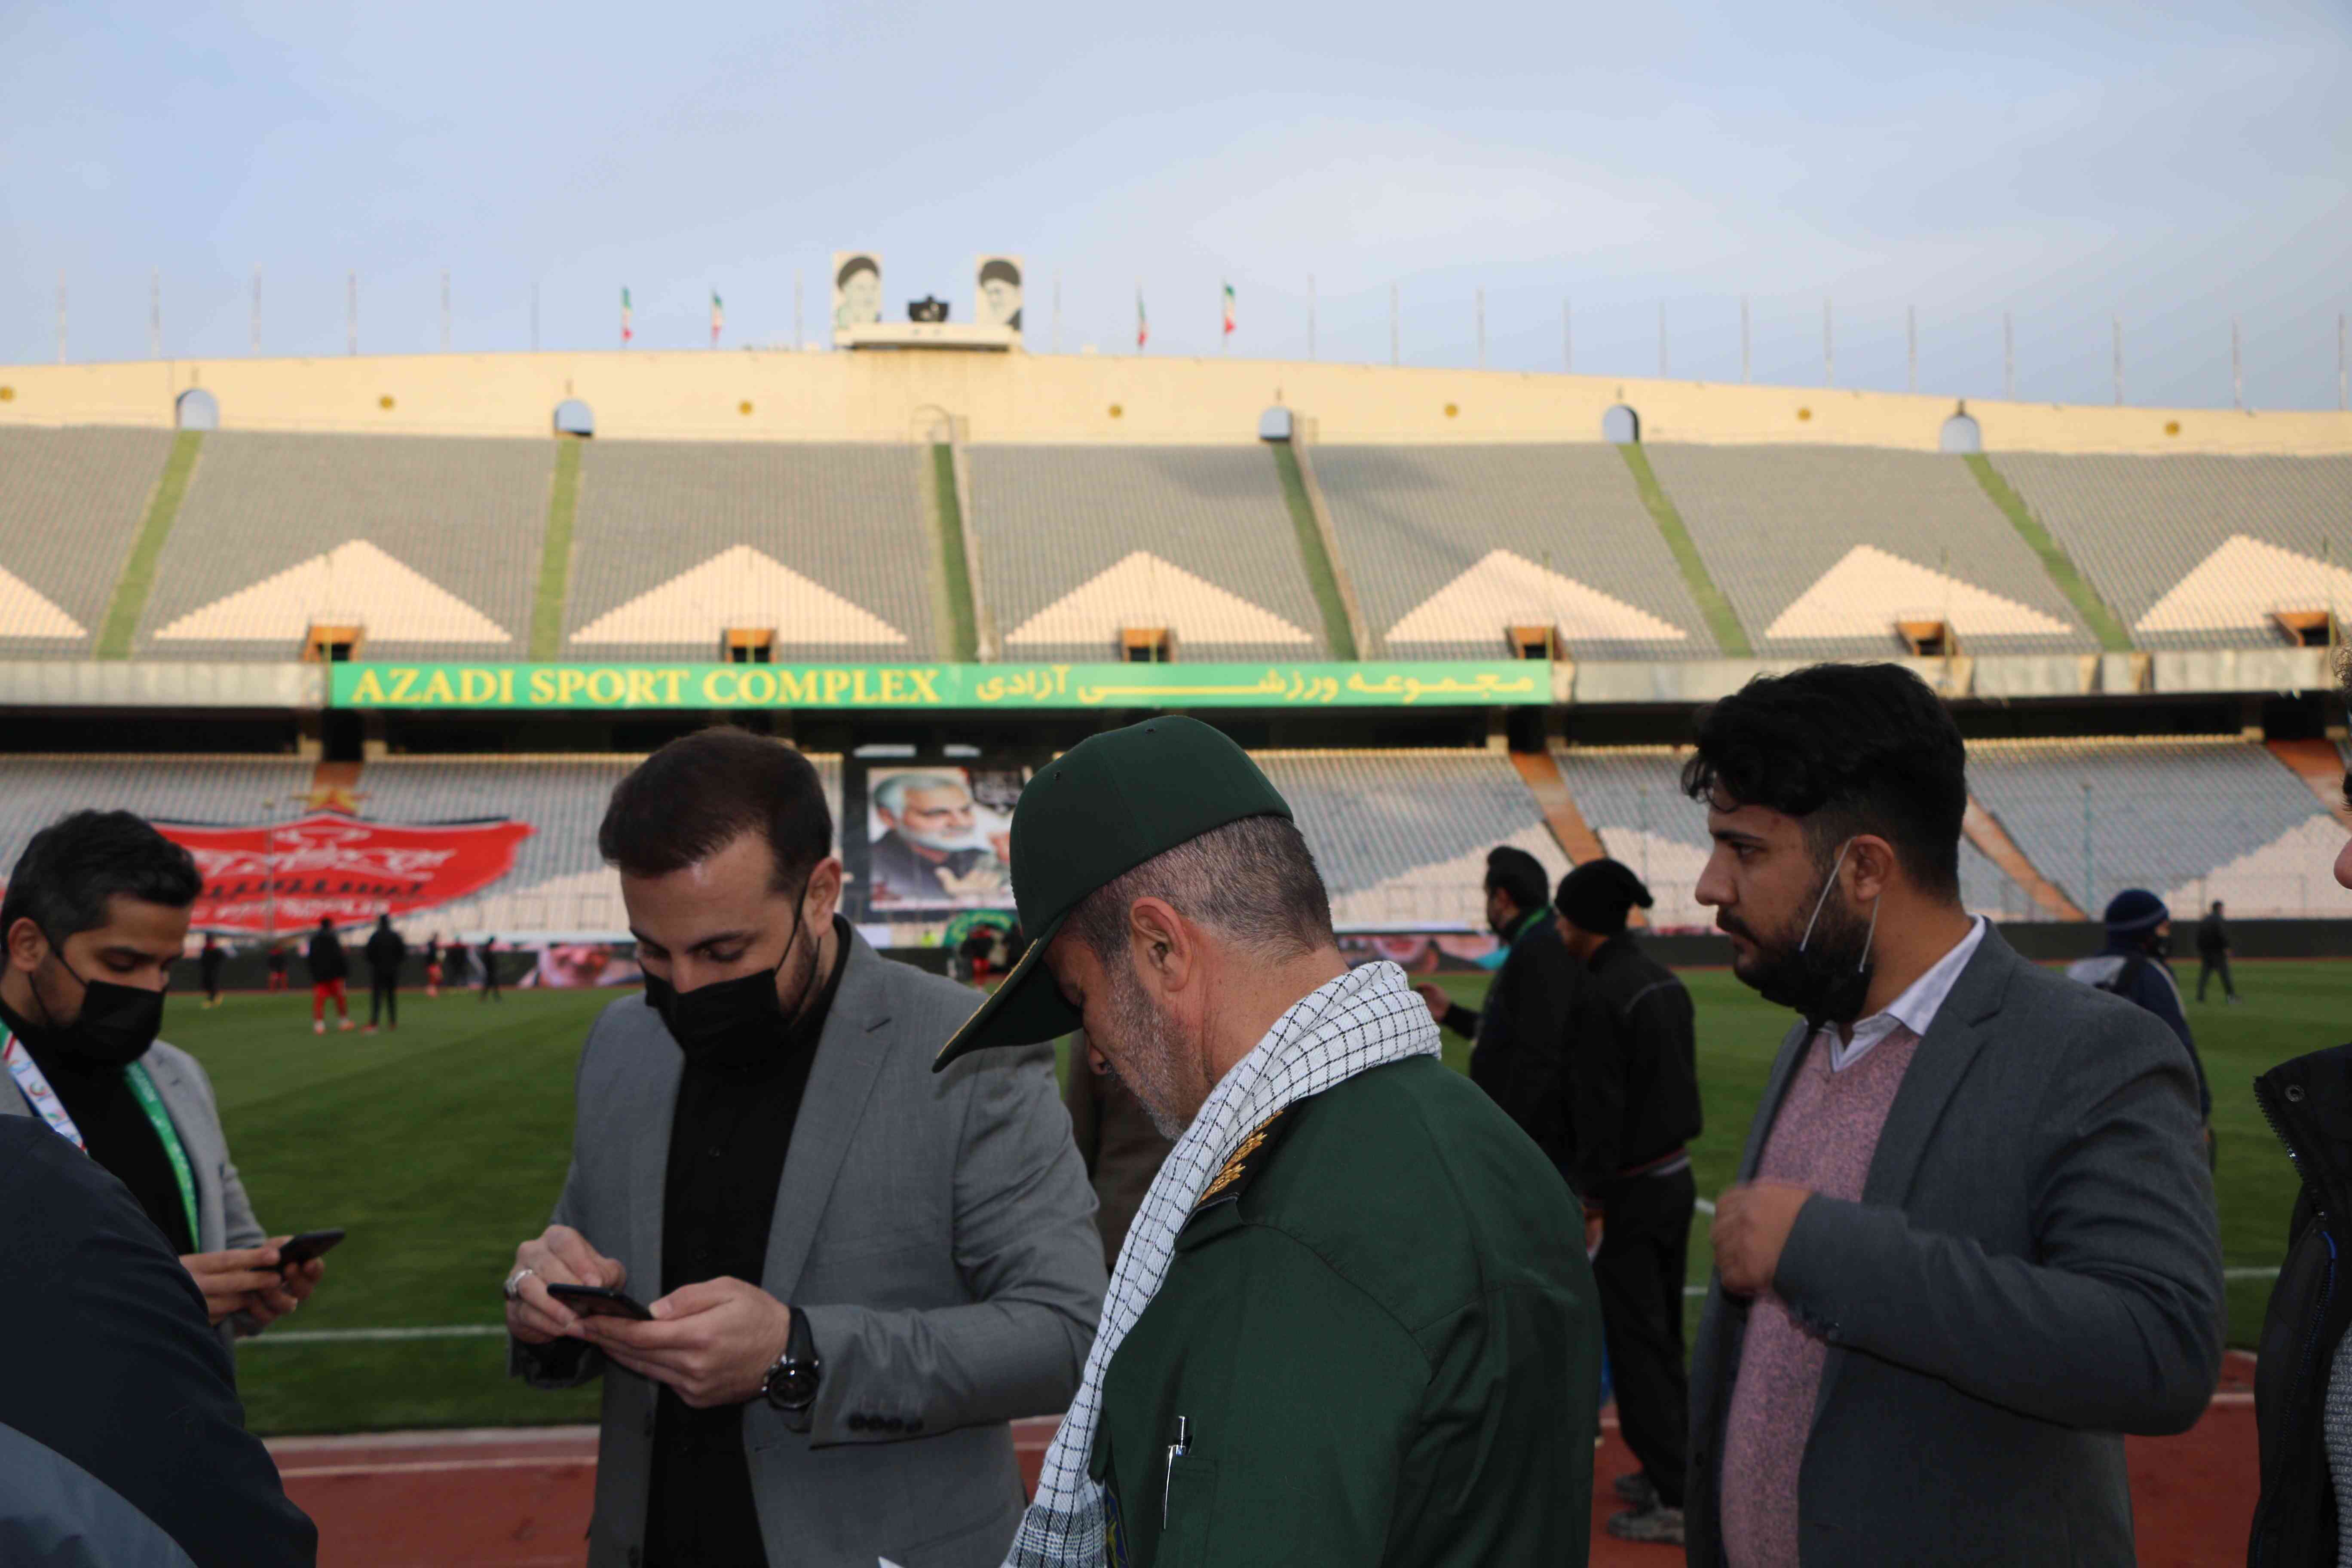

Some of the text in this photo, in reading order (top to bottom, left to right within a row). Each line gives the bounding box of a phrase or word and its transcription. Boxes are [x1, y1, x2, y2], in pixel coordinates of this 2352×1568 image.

[351, 668, 941, 705] AZADI SPORT COMPLEX
[976, 664, 1071, 702] آزادی
[1346, 672, 1535, 704] مجموعه
